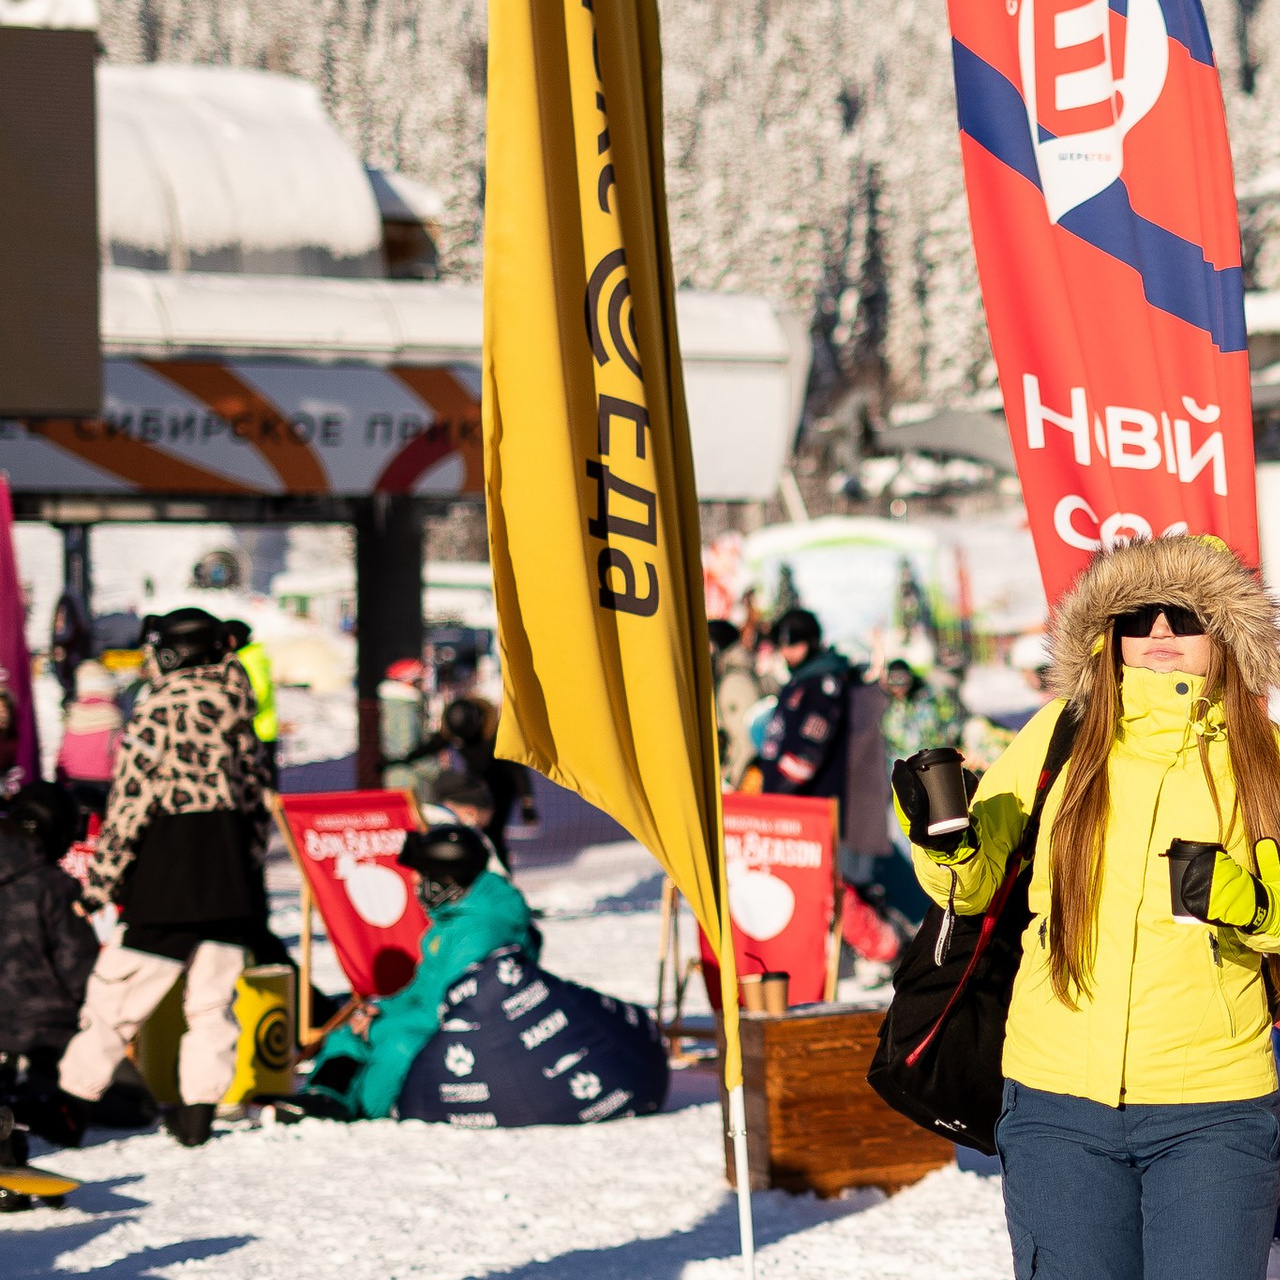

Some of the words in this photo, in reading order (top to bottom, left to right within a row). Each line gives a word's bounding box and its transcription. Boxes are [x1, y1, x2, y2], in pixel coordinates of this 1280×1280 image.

[74, 408, 342, 446] СИБИРСКОЕ
[365, 412, 482, 448] ПРИК
[586, 401, 660, 617] Еда
